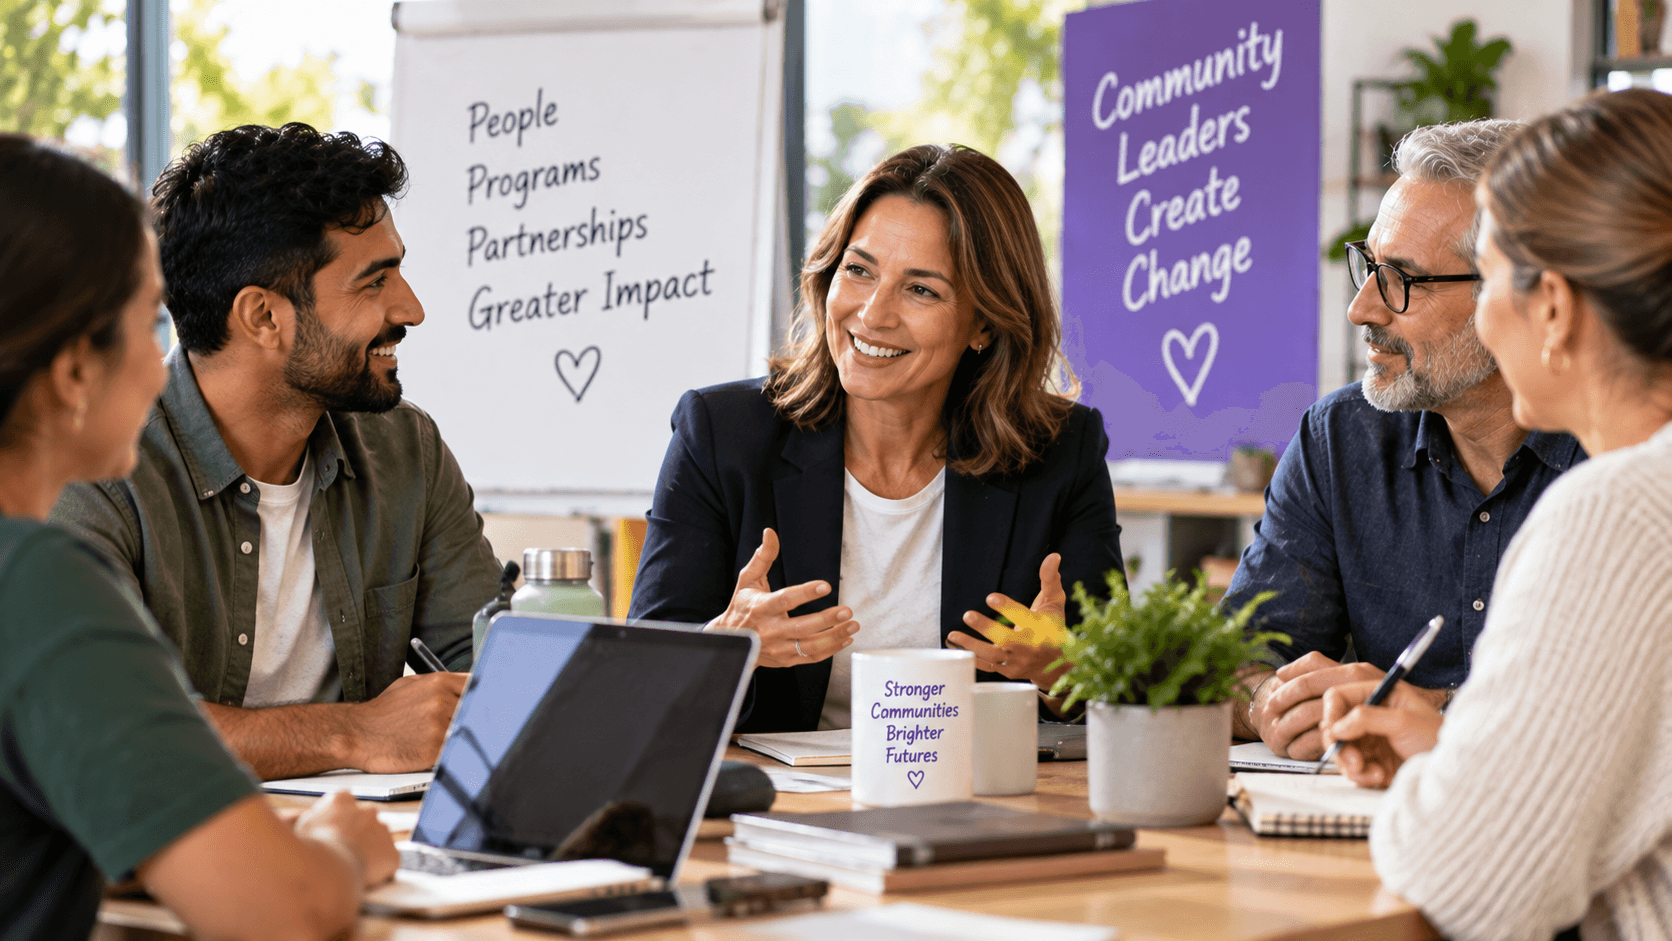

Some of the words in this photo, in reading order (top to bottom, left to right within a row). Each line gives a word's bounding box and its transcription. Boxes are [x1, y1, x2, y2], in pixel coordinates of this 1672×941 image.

[1092, 21, 1283, 130] Community
[467, 87, 558, 147] People
[1117, 103, 1250, 185] Leaders
[466, 156, 601, 210] Programs
[1125, 166, 1241, 246] Create
[466, 206, 649, 267] Partnerships
[468, 281, 588, 331] Greater
[601, 259, 716, 321] Impact
[1122, 236, 1252, 312] Change
[884, 680, 945, 701] Stronger
[886, 724, 944, 745] Brighter
[886, 746, 938, 763] Futures
